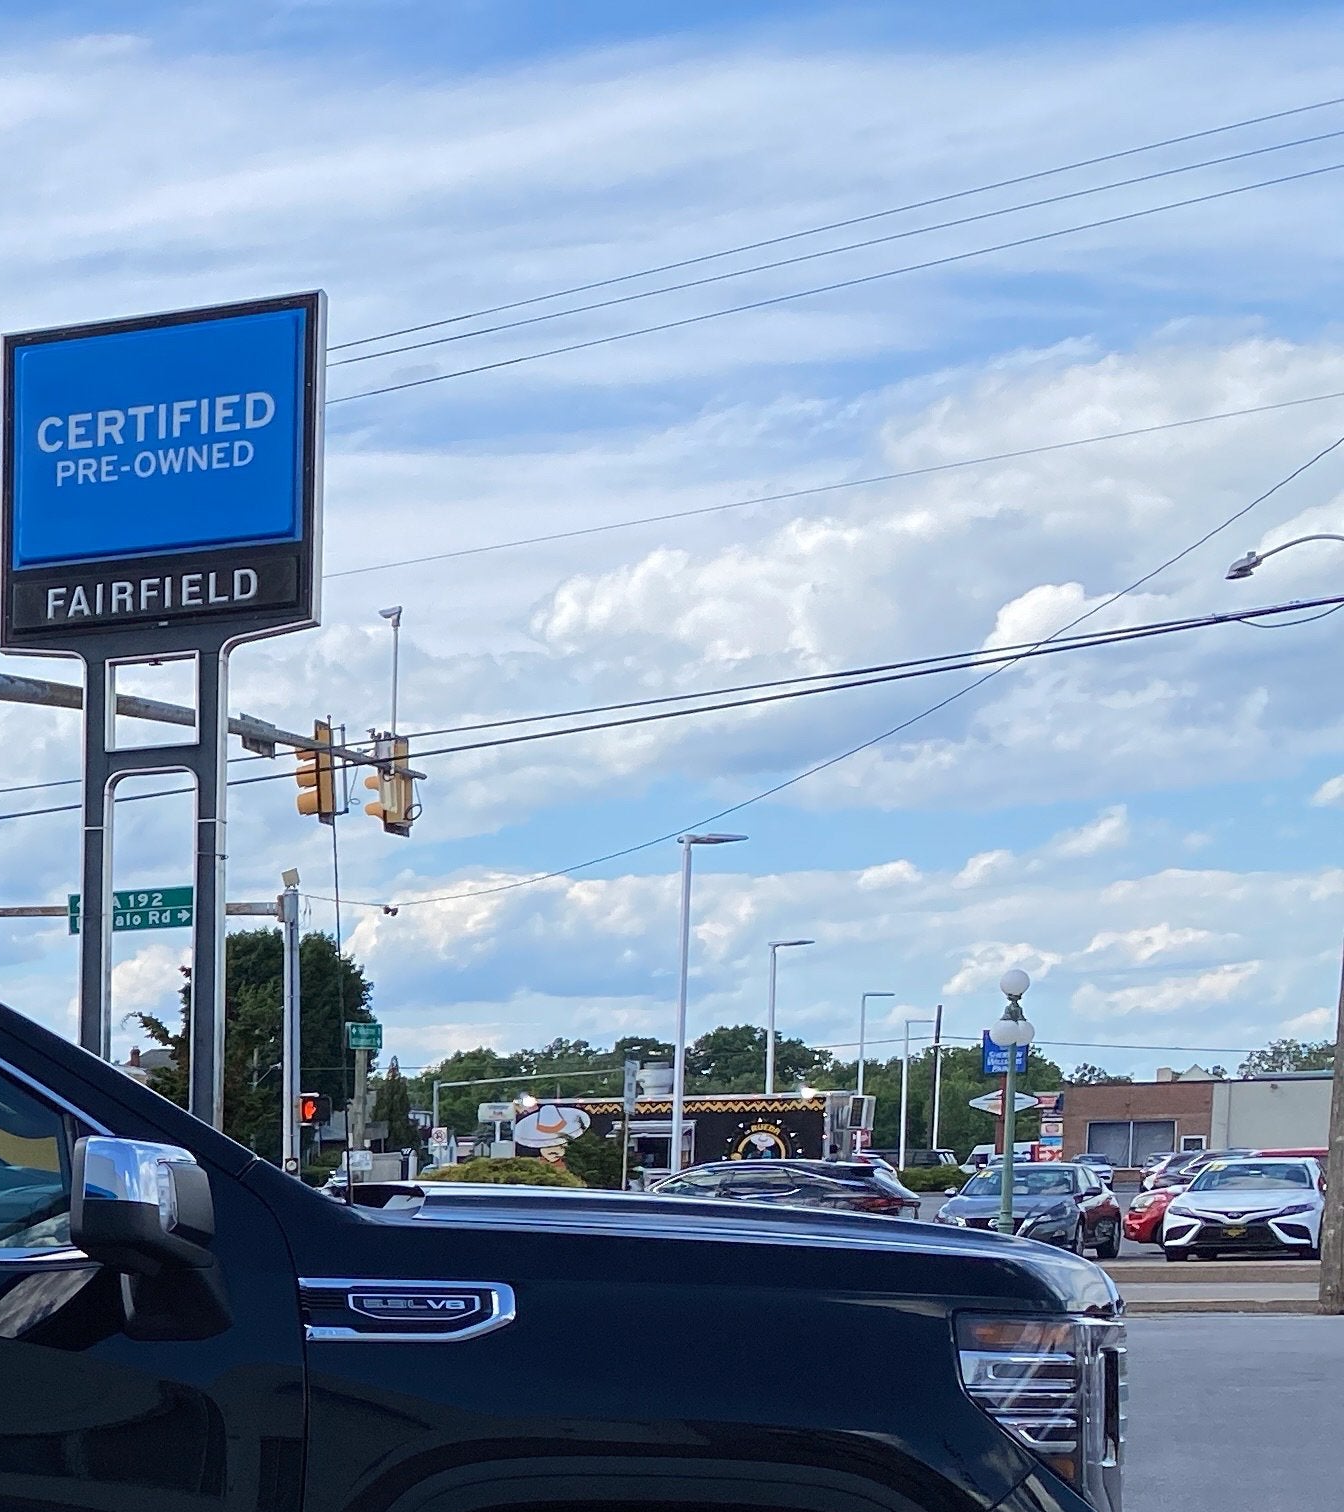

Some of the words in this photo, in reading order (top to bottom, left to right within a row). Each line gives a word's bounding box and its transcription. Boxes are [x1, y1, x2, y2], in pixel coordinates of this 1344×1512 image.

[37, 391, 276, 454] CERTIFIED
[56, 439, 255, 487] PRE-OWNED
[46, 568, 258, 620] FAIRFIELD
[128, 892, 164, 908] 192
[148, 909, 171, 925] Rd
